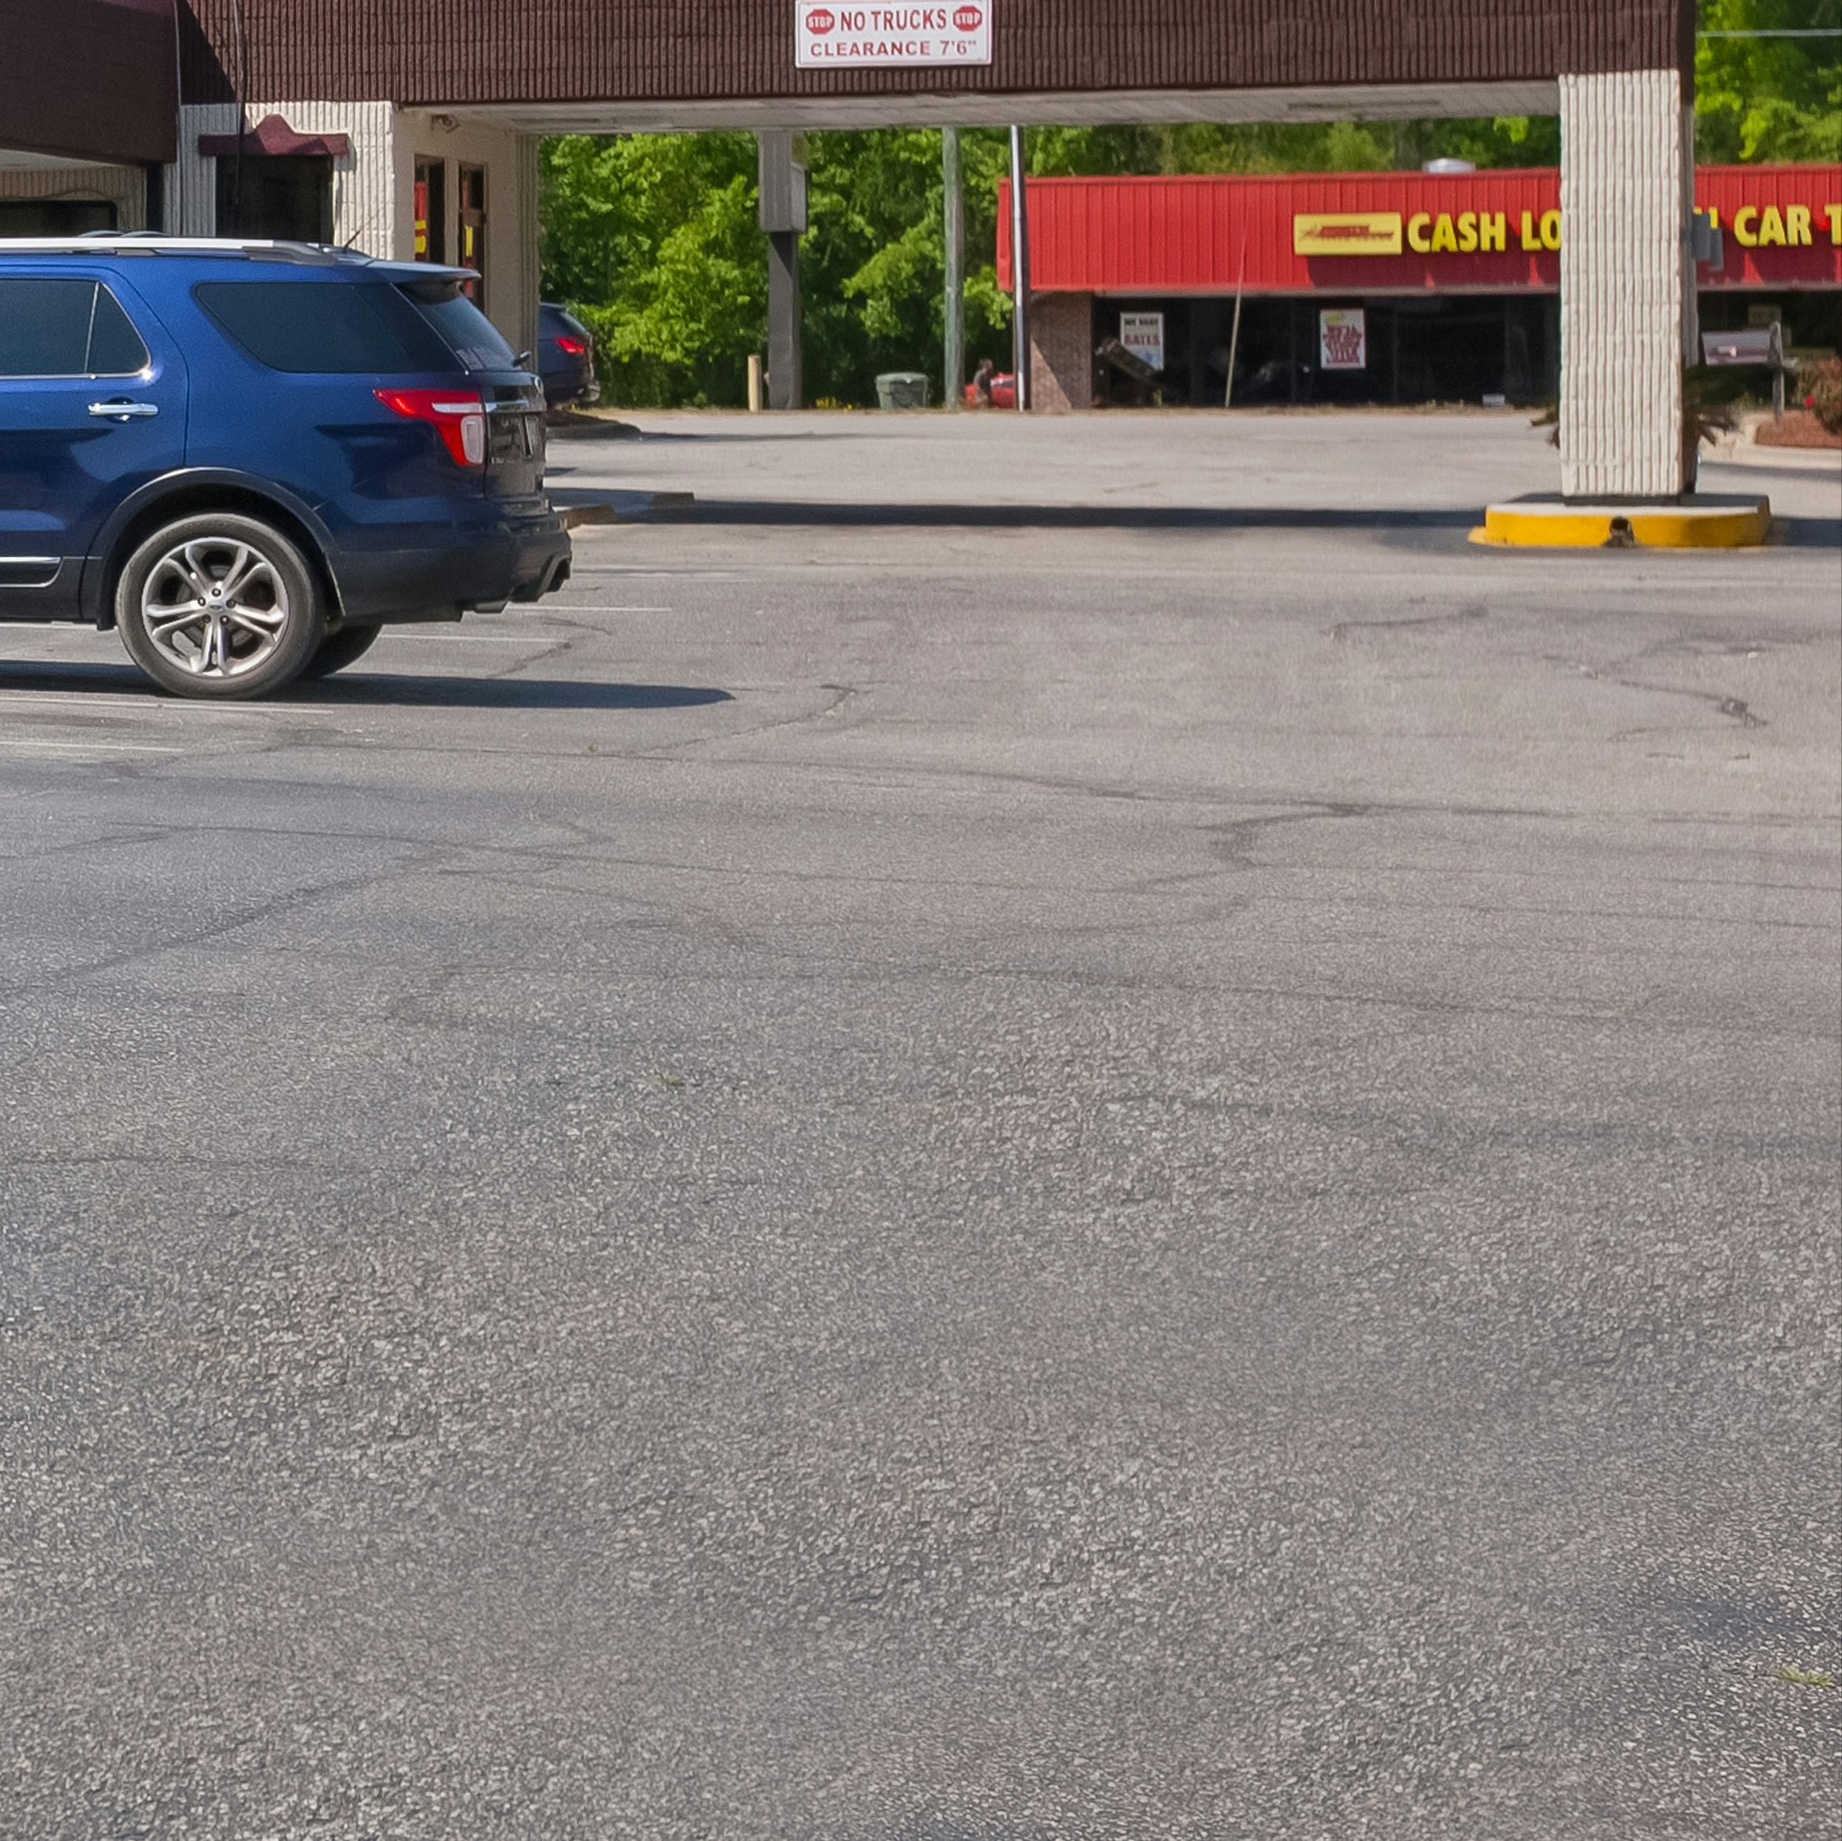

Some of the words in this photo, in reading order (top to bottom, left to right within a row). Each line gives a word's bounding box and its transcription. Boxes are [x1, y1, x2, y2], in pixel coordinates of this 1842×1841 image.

[807, 15, 833, 28] STOP
[840, 11, 866, 32] NO
[871, 8, 947, 31] TRUCKS
[954, 11, 981, 26] STOP
[810, 40, 931, 57] CLEARANCE
[1407, 211, 1506, 252] CASH
[1733, 203, 1813, 247] CAR
